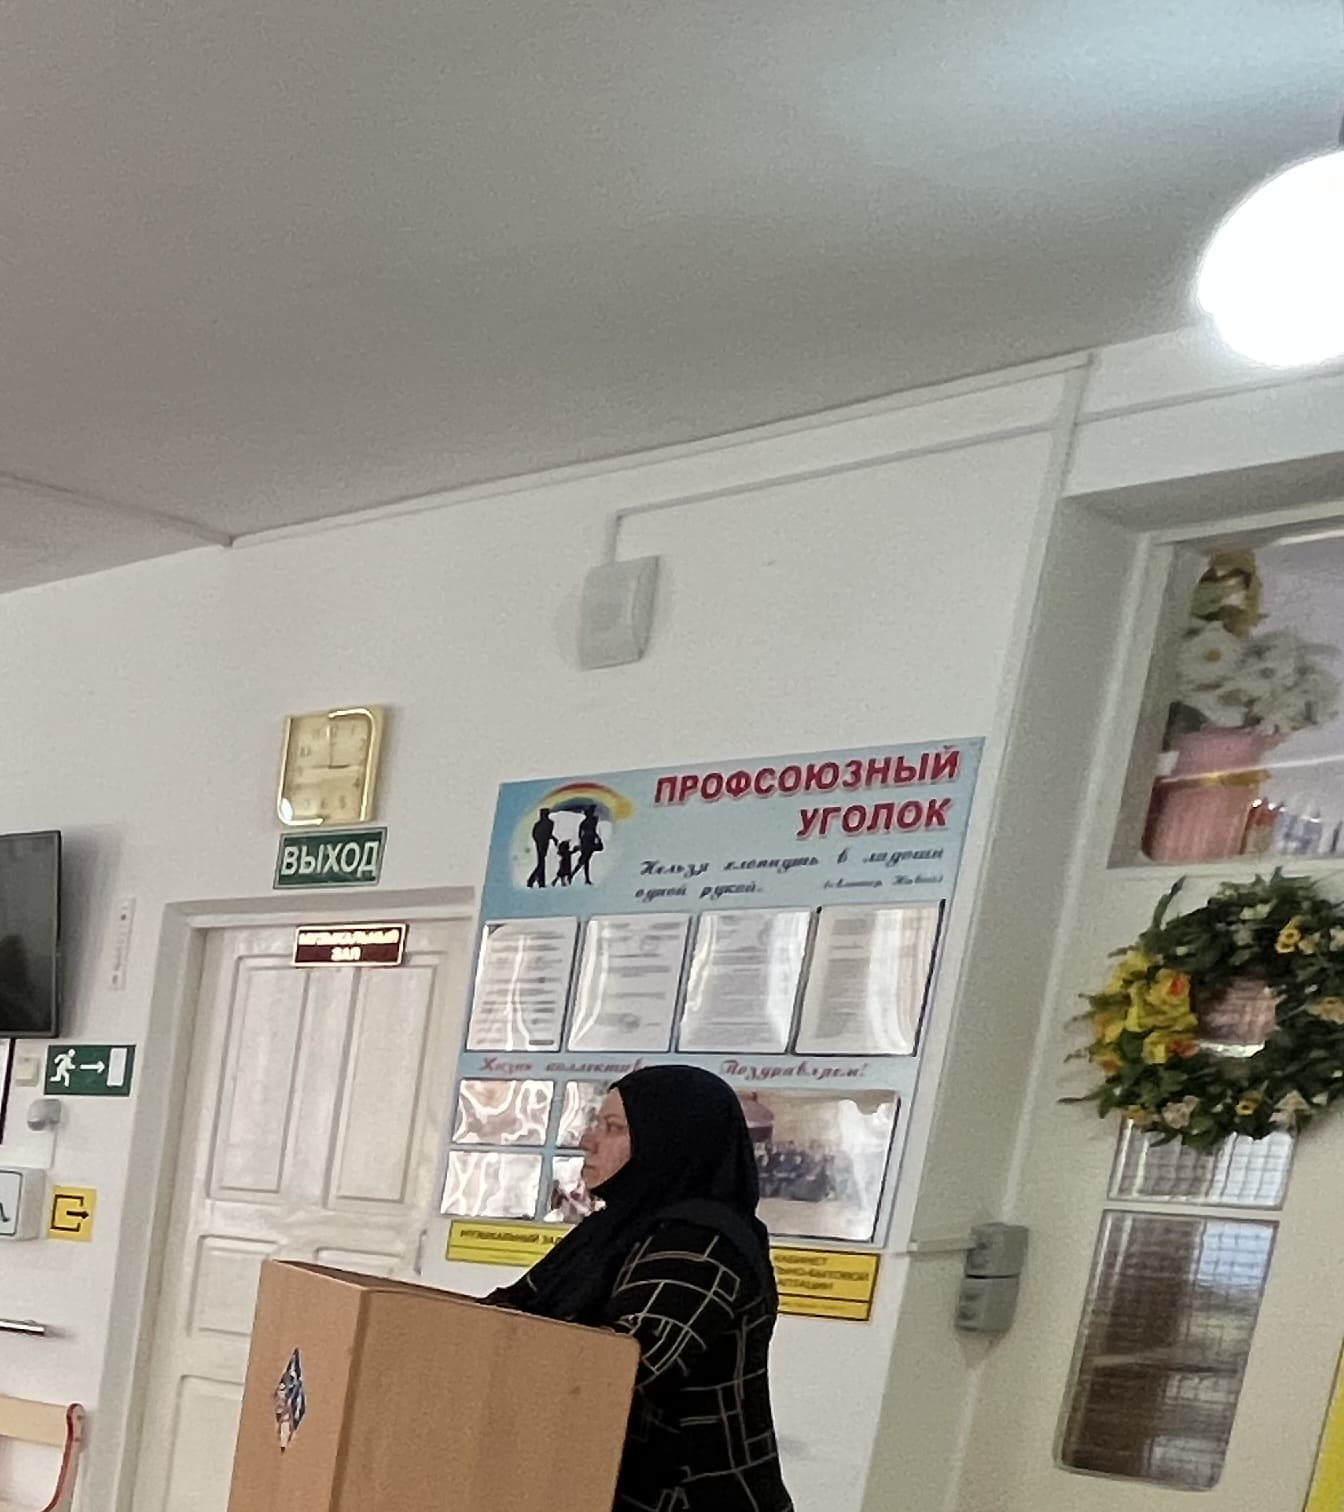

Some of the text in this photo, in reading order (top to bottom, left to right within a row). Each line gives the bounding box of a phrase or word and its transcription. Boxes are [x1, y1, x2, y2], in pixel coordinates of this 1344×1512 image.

[653, 745, 960, 805] ПРОФСОЮЗНЫЙ
[796, 797, 952, 838] УГОЛОК
[280, 841, 380, 878] ВЫХОД
